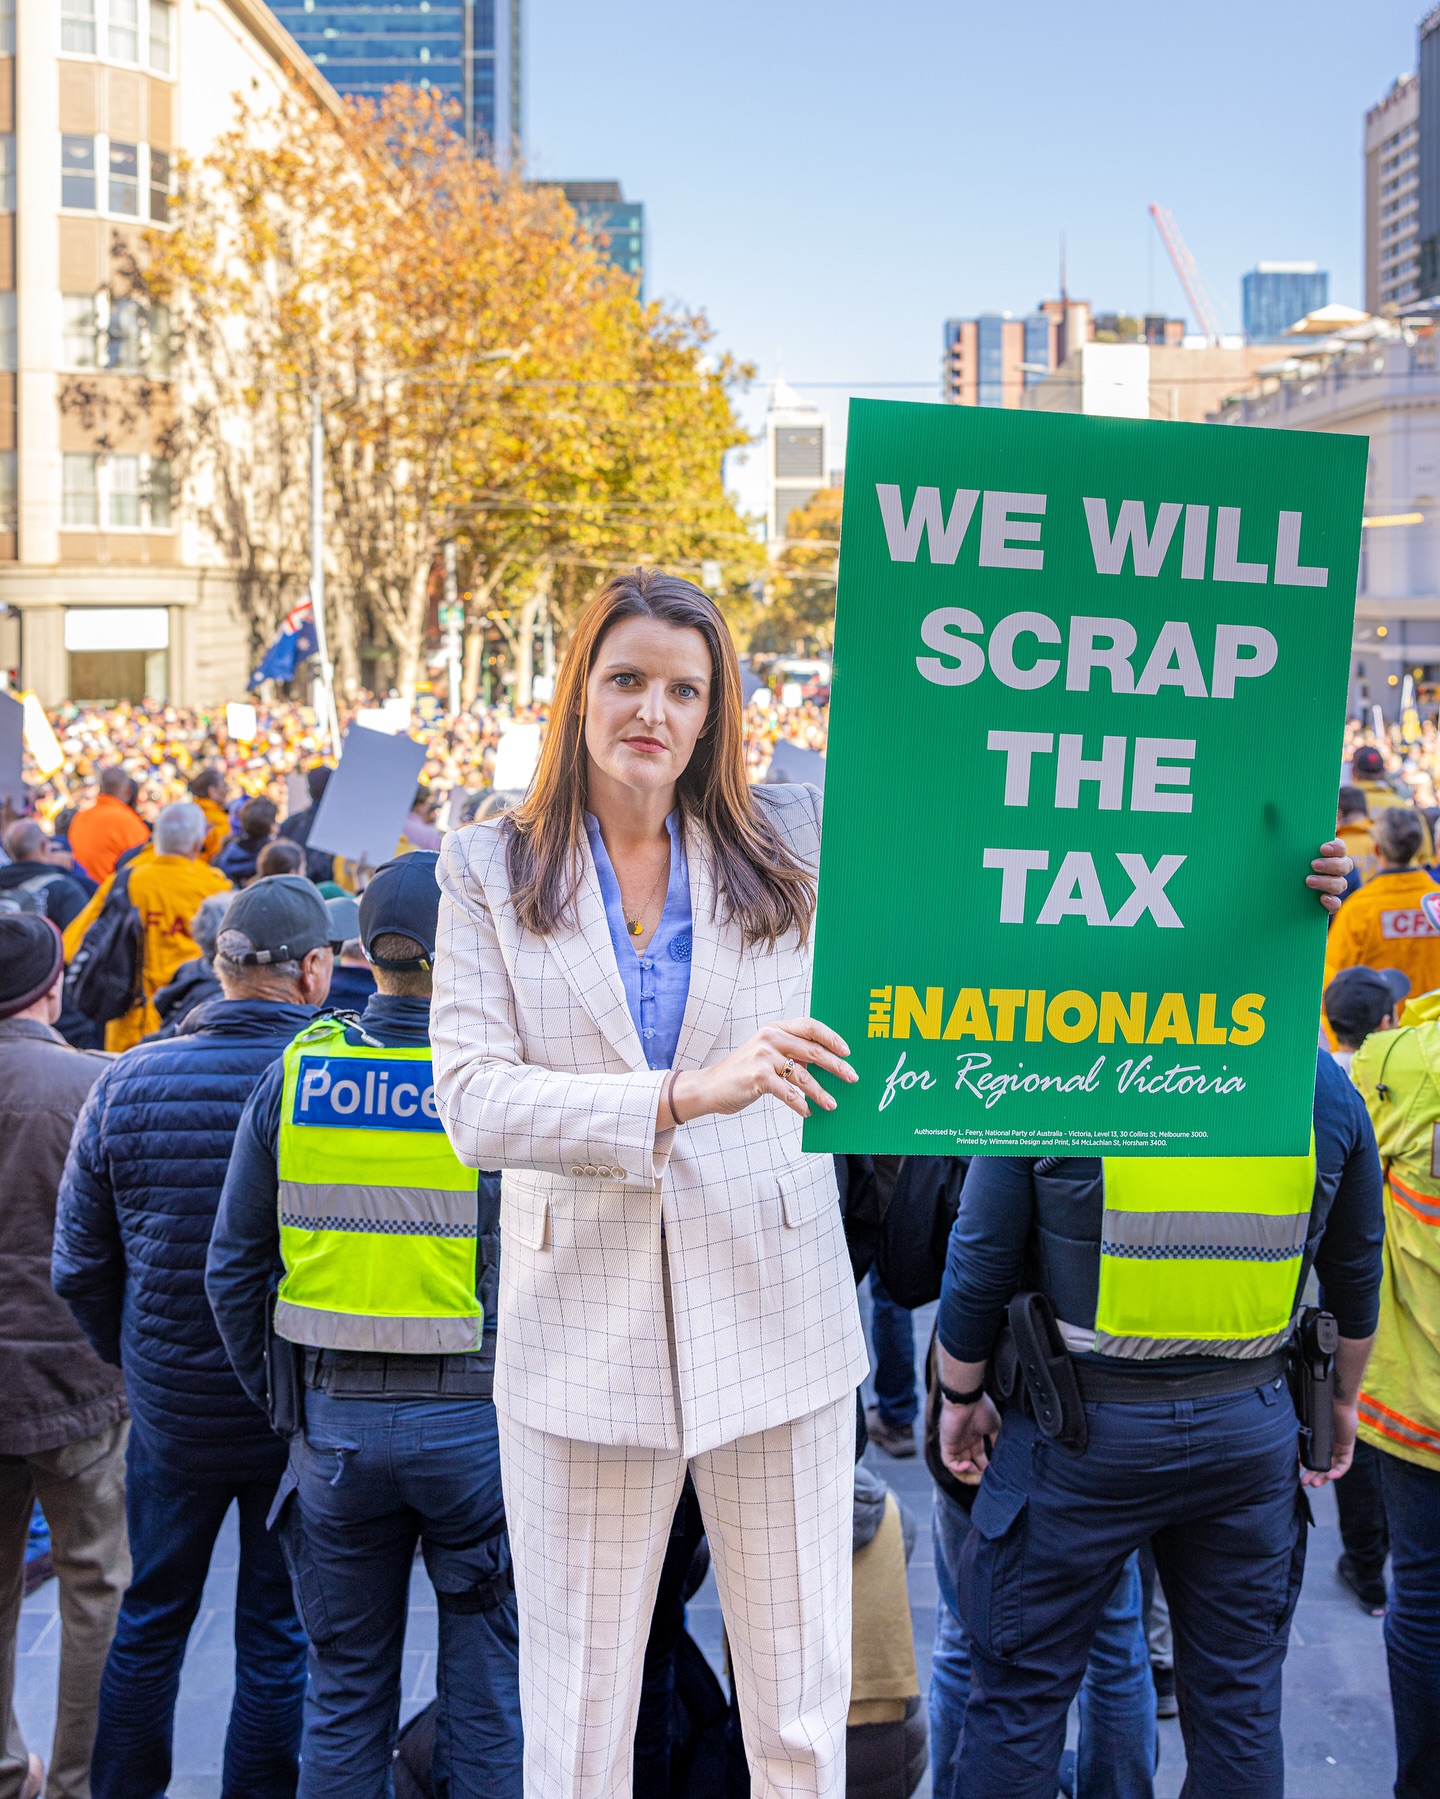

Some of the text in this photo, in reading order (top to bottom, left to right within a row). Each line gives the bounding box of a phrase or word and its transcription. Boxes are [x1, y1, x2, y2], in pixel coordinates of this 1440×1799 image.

[876, 483, 1329, 588] WE WILL
[915, 606, 1279, 699] SCRAP
[986, 730, 1197, 814] THE
[982, 847, 1188, 929] TAX
[868, 986, 1266, 1047] THE NATIONALS
[879, 1052, 1246, 1112] for Regional Victoria
[949, 1128, 957, 1136] by
[1068, 1130, 1093, 1138] Victoria,
